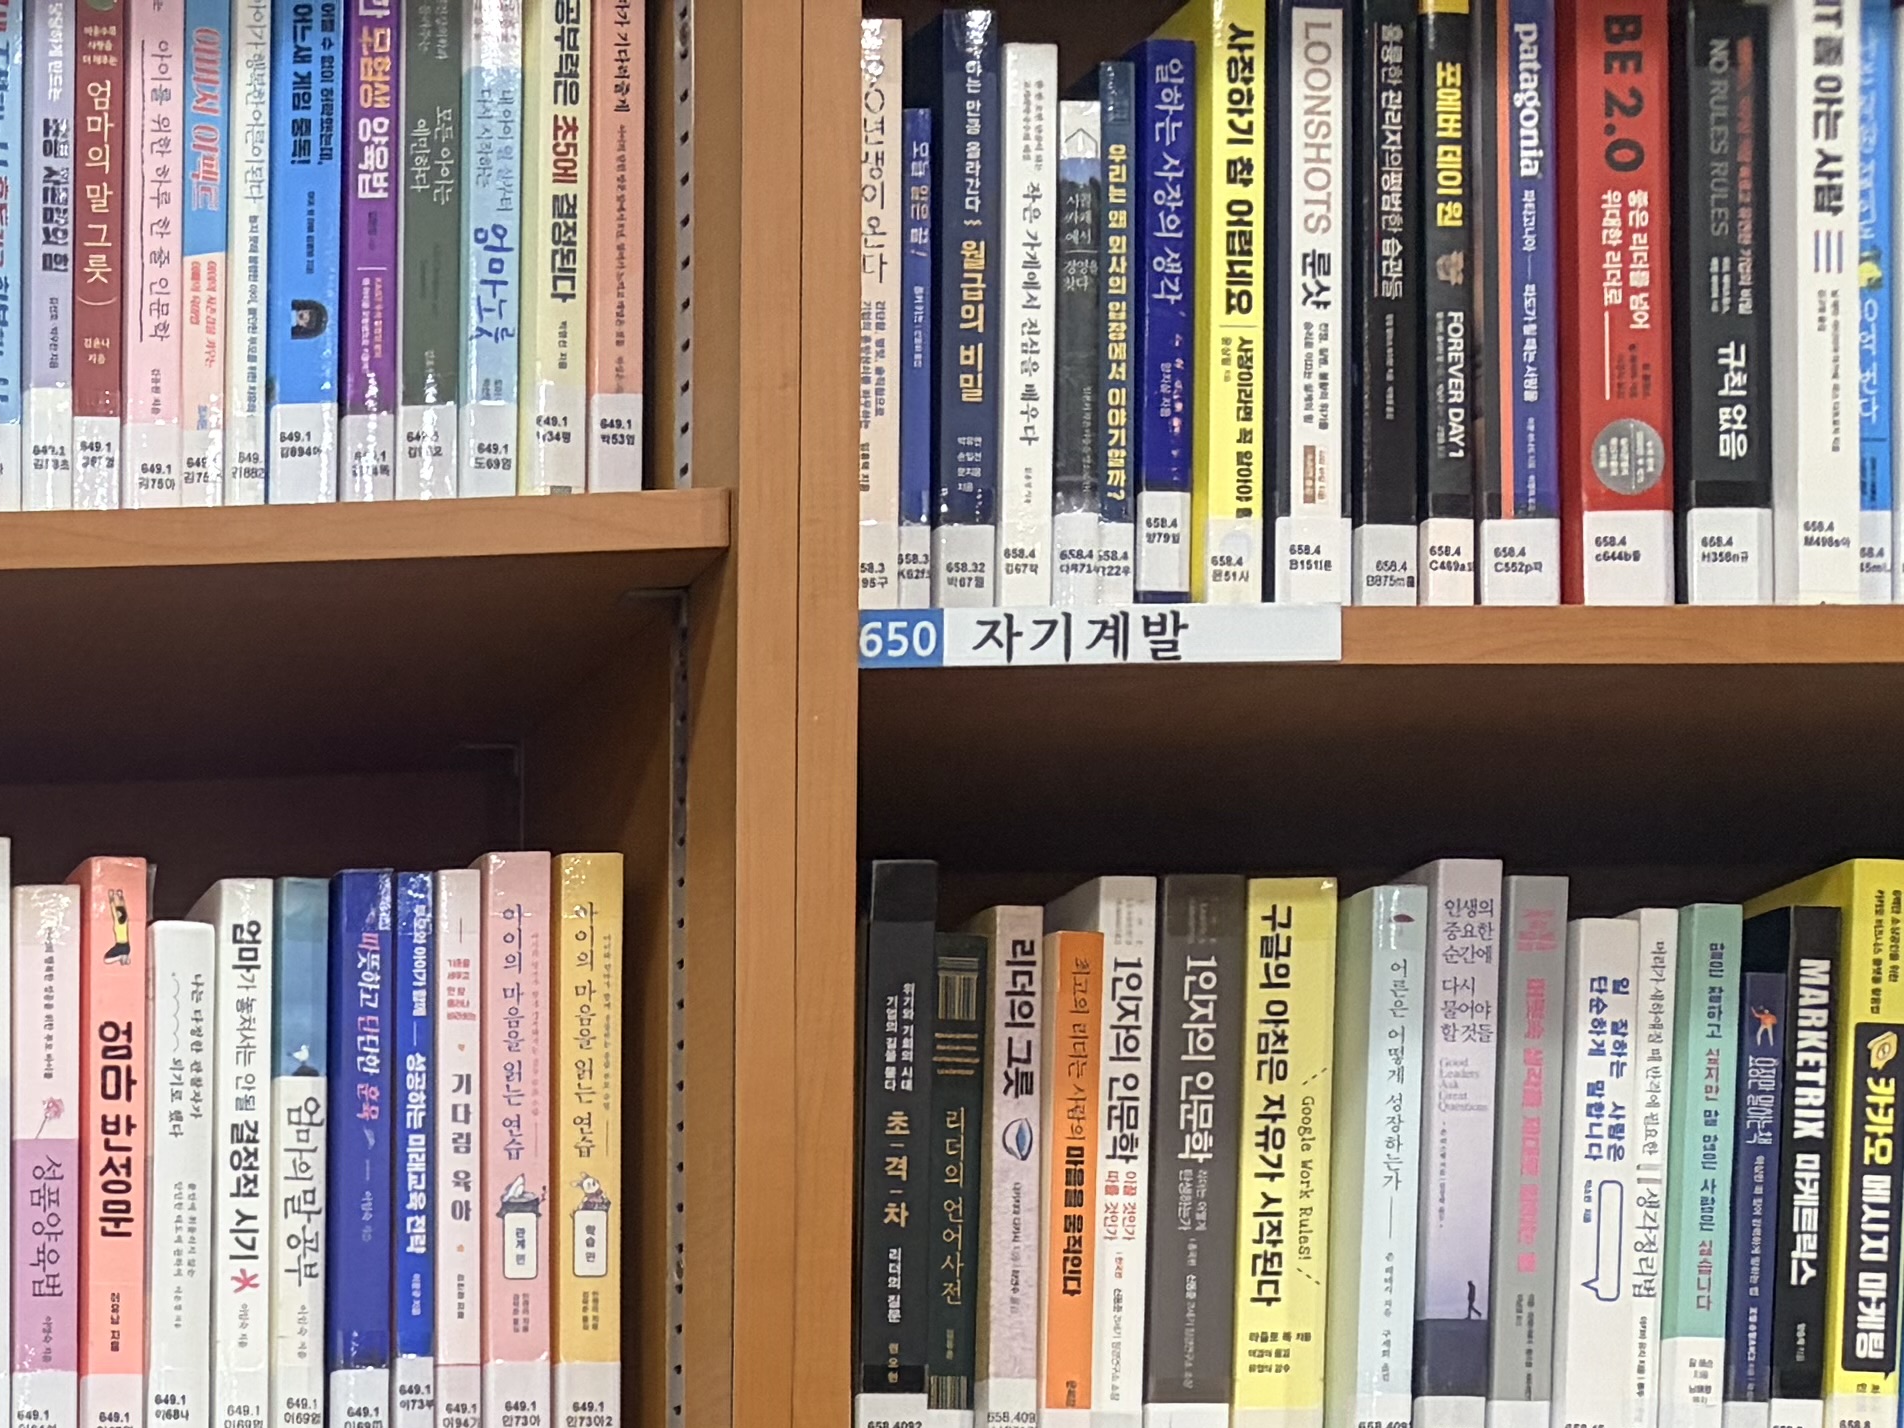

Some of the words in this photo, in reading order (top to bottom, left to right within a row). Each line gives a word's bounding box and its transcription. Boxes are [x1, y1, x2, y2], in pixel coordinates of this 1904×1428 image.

[1604, 14, 1642, 75] BE
[1302, 20, 1332, 234] LOONSHOTS
[1514, 22, 1546, 179] patagonia
[1604, 87, 1645, 172] 2.0
[1302, 249, 1331, 309] 룬샷
[1718, 341, 1747, 396] 규칙
[1718, 404, 1748, 460] 없음
[1494, 547, 1526, 557] 658.4
[860, 621, 936, 657] 650
[972, 610, 1188, 663] 자기계발
[1260, 904, 1291, 988] 구글의
[99, 1021, 137, 1102] 엄마
[1257, 1000, 1289, 1084] 아침은
[1794, 957, 1830, 1139] MARKETRIX
[1255, 1094, 1286, 1182] 자유가
[1297, 1096, 1316, 1152] Google
[99, 1114, 137, 1237] 반성문
[1299, 1159, 1314, 1199] Work
[1250, 1192, 1283, 1306] 시작된다
[1299, 1207, 1313, 1259] Rules!
[1791, 1153, 1820, 1286] 마케트릭스
[573, 1402, 604, 1412] 649.1
